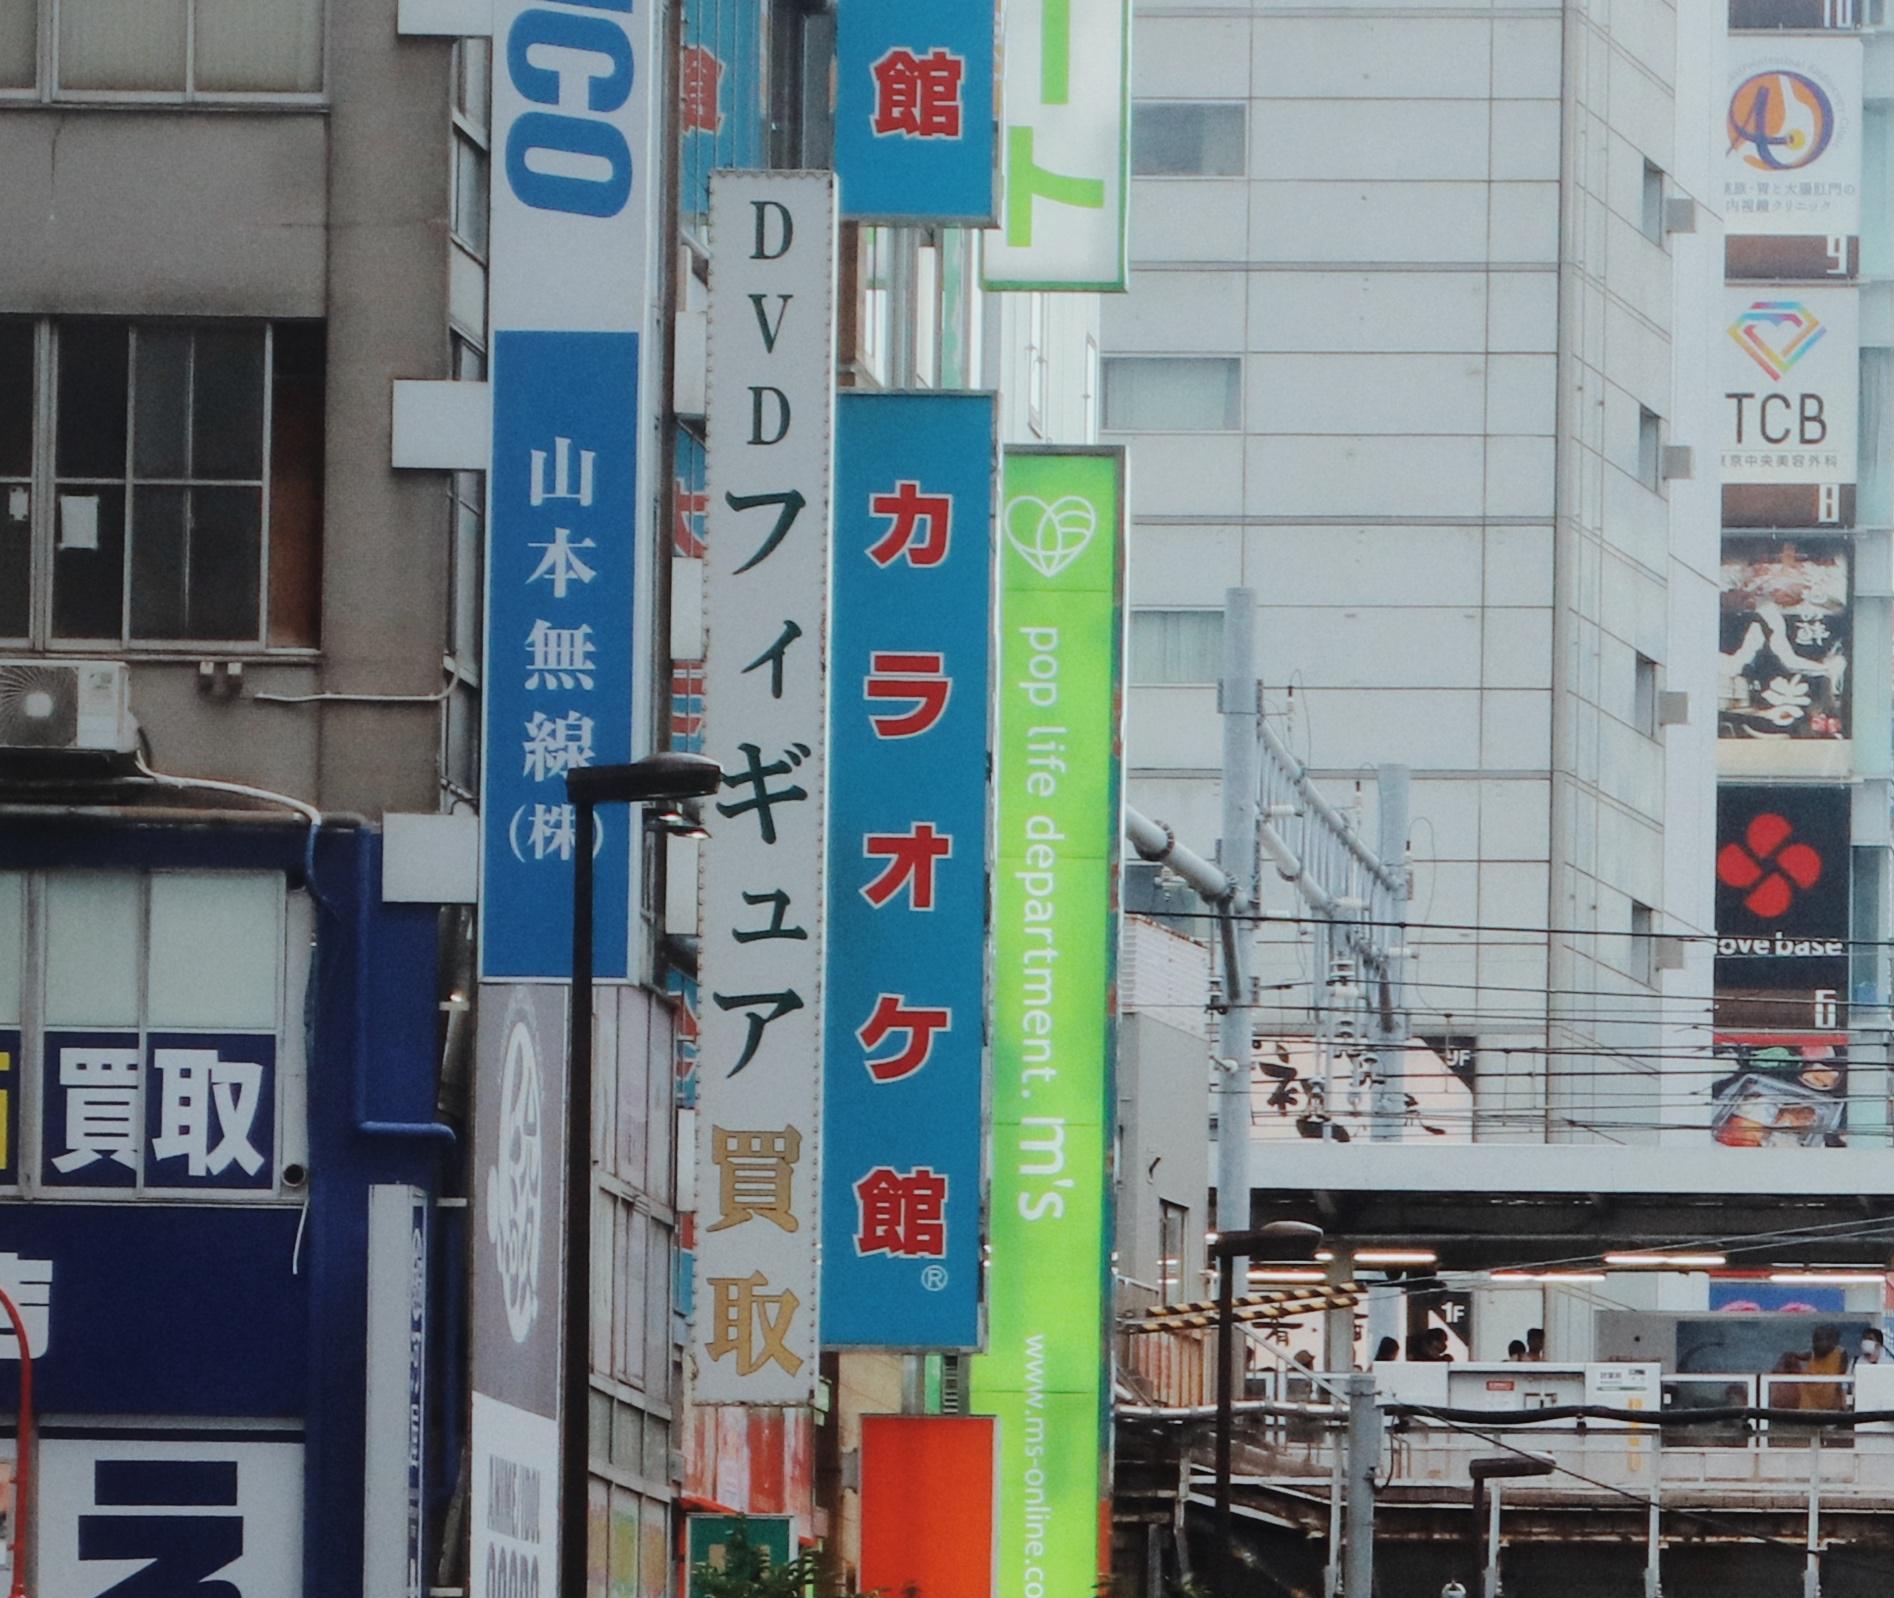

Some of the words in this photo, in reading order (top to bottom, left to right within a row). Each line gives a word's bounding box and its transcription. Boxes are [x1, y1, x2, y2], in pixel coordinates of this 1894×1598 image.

[505, 0, 635, 219] CO
[870, 46, 966, 141] 館
[1725, 392, 1828, 446] TCB
[1018, 627, 1059, 708] pop
[1026, 724, 1067, 798] life
[852, 479, 954, 1259] カラオケ館
[1014, 813, 1065, 1099] department.
[1775, 931, 1844, 957] base
[51, 1046, 266, 1177] 買取
[1442, 1302, 1465, 1324] 1F
